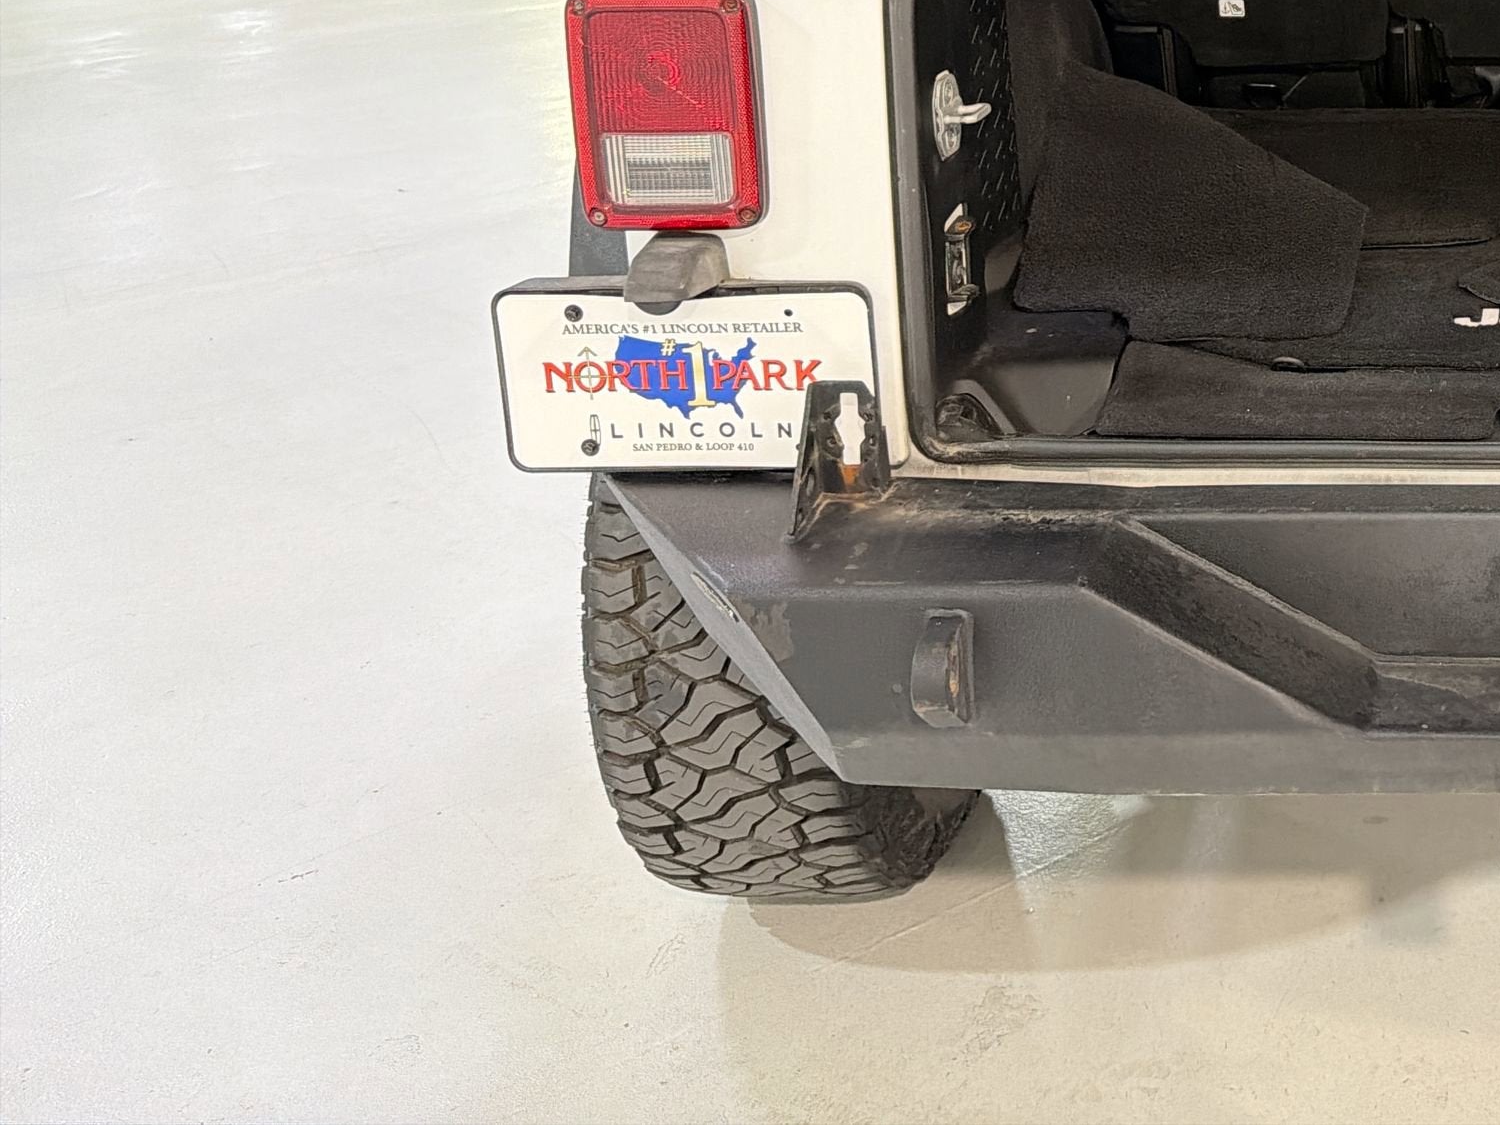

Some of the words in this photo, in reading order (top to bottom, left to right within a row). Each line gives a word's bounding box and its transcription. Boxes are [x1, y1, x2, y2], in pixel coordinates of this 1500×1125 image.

[562, 323, 639, 335] AMERICA'S
[642, 324, 658, 334] #1
[661, 323, 728, 334] LINCOLN
[732, 322, 804, 333] RETAILER
[542, 359, 689, 393] NORTH
[712, 359, 822, 392] PARK
[611, 422, 793, 439] LINCOLN
[632, 443, 653, 452] SAN
[656, 443, 692, 451] PEDRO
[695, 443, 704, 451] &
[706, 443, 735, 451] LOOP
[737, 442, 755, 451] 410
